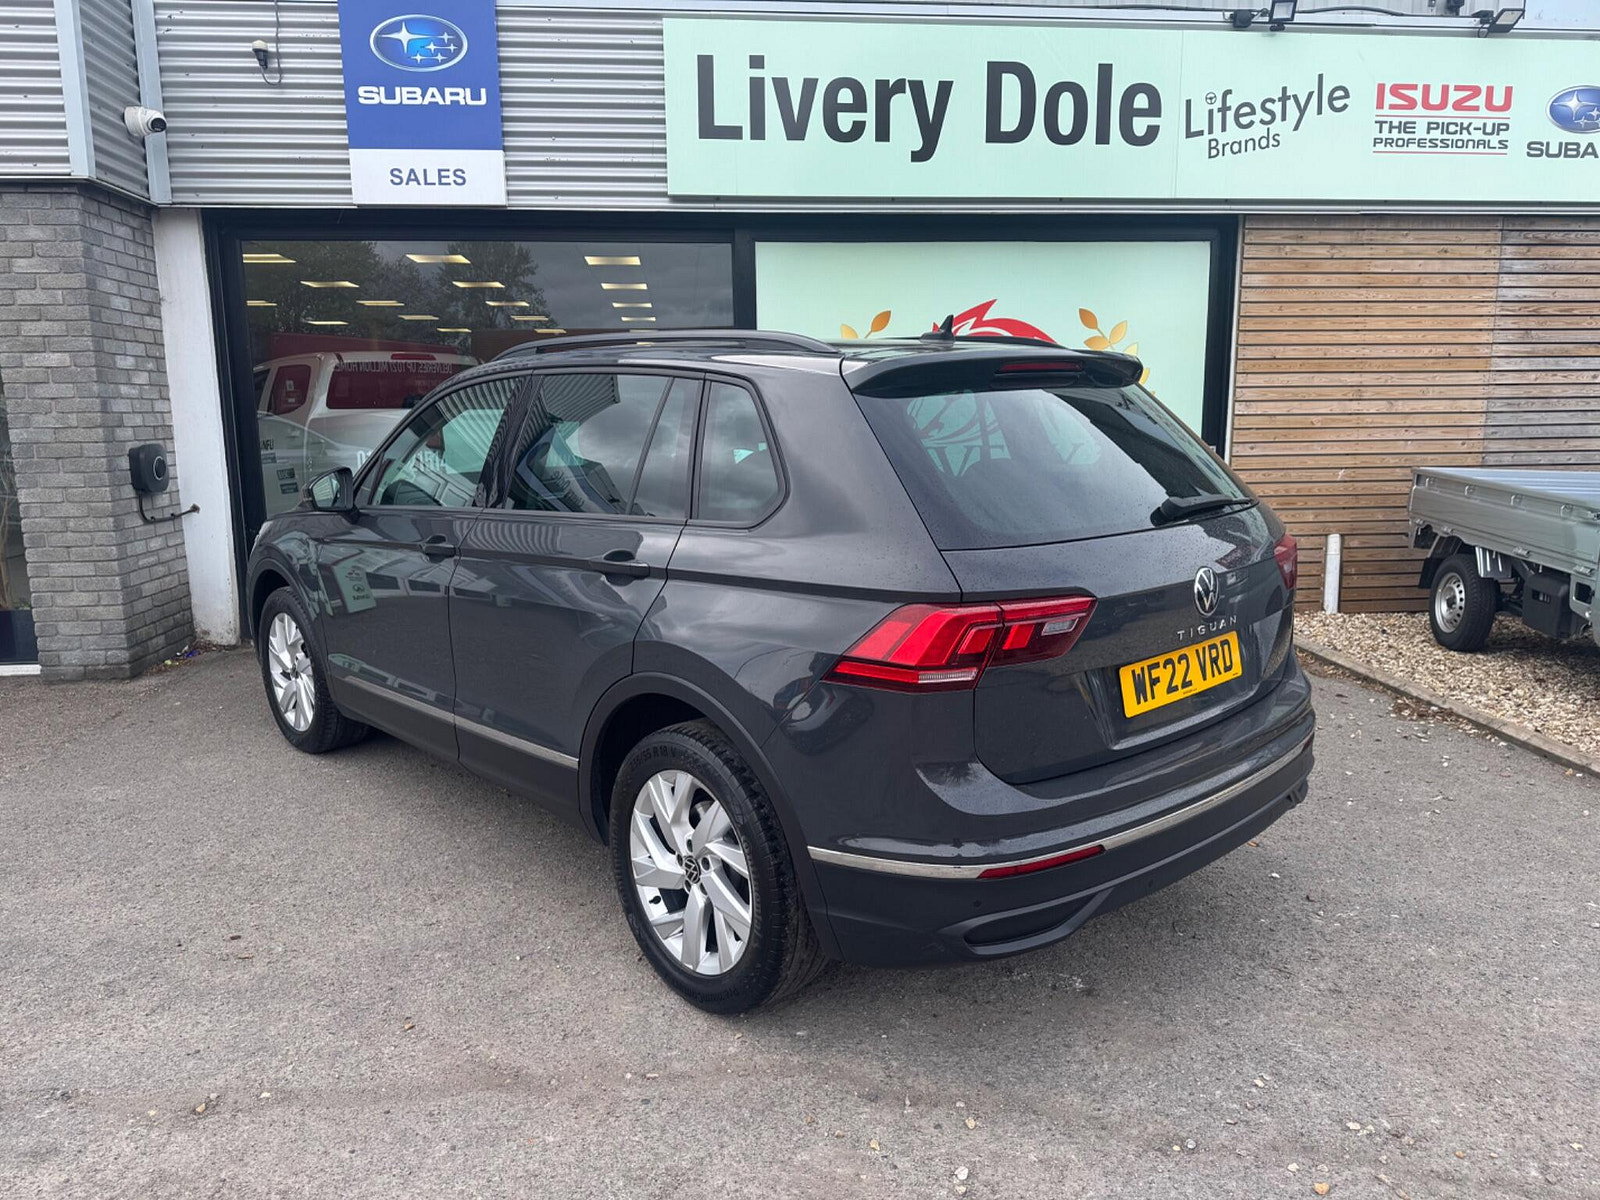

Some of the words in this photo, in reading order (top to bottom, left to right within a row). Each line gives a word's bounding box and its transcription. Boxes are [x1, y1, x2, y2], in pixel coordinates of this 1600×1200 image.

[358, 85, 487, 106] SUBARU
[697, 54, 955, 163] Livery
[985, 60, 1162, 147] Dole
[1185, 73, 1351, 140] Lifestyle
[1375, 82, 1514, 113] ISUZU
[1375, 120, 1417, 135] THE
[1425, 121, 1510, 137] PICK-UP
[1207, 133, 1281, 160] Brands
[1372, 137, 1509, 150] PROFESSIONALS
[390, 167, 467, 187] SALES
[1176, 615, 1237, 640] TIGUAN
[1131, 654, 1193, 706] WF22
[1195, 638, 1234, 682] VRD
